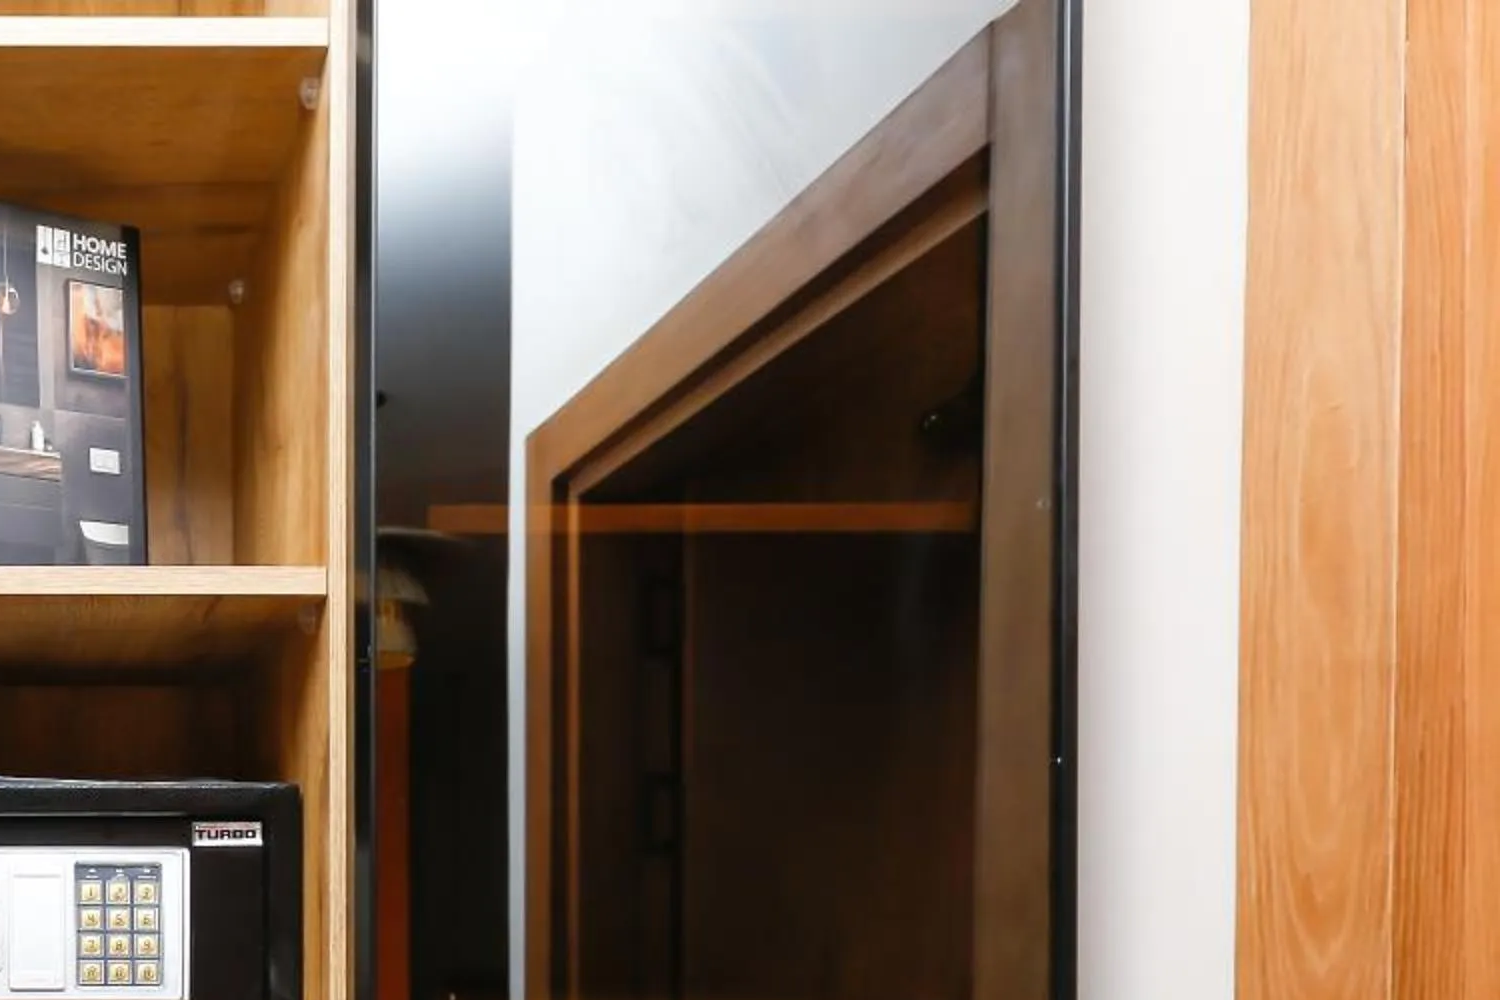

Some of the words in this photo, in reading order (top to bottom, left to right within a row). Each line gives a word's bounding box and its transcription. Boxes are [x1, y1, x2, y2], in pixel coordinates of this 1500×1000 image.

[73, 233, 127, 259] HOME
[73, 251, 128, 276] DESIGN
[195, 829, 256, 840] TURBO
